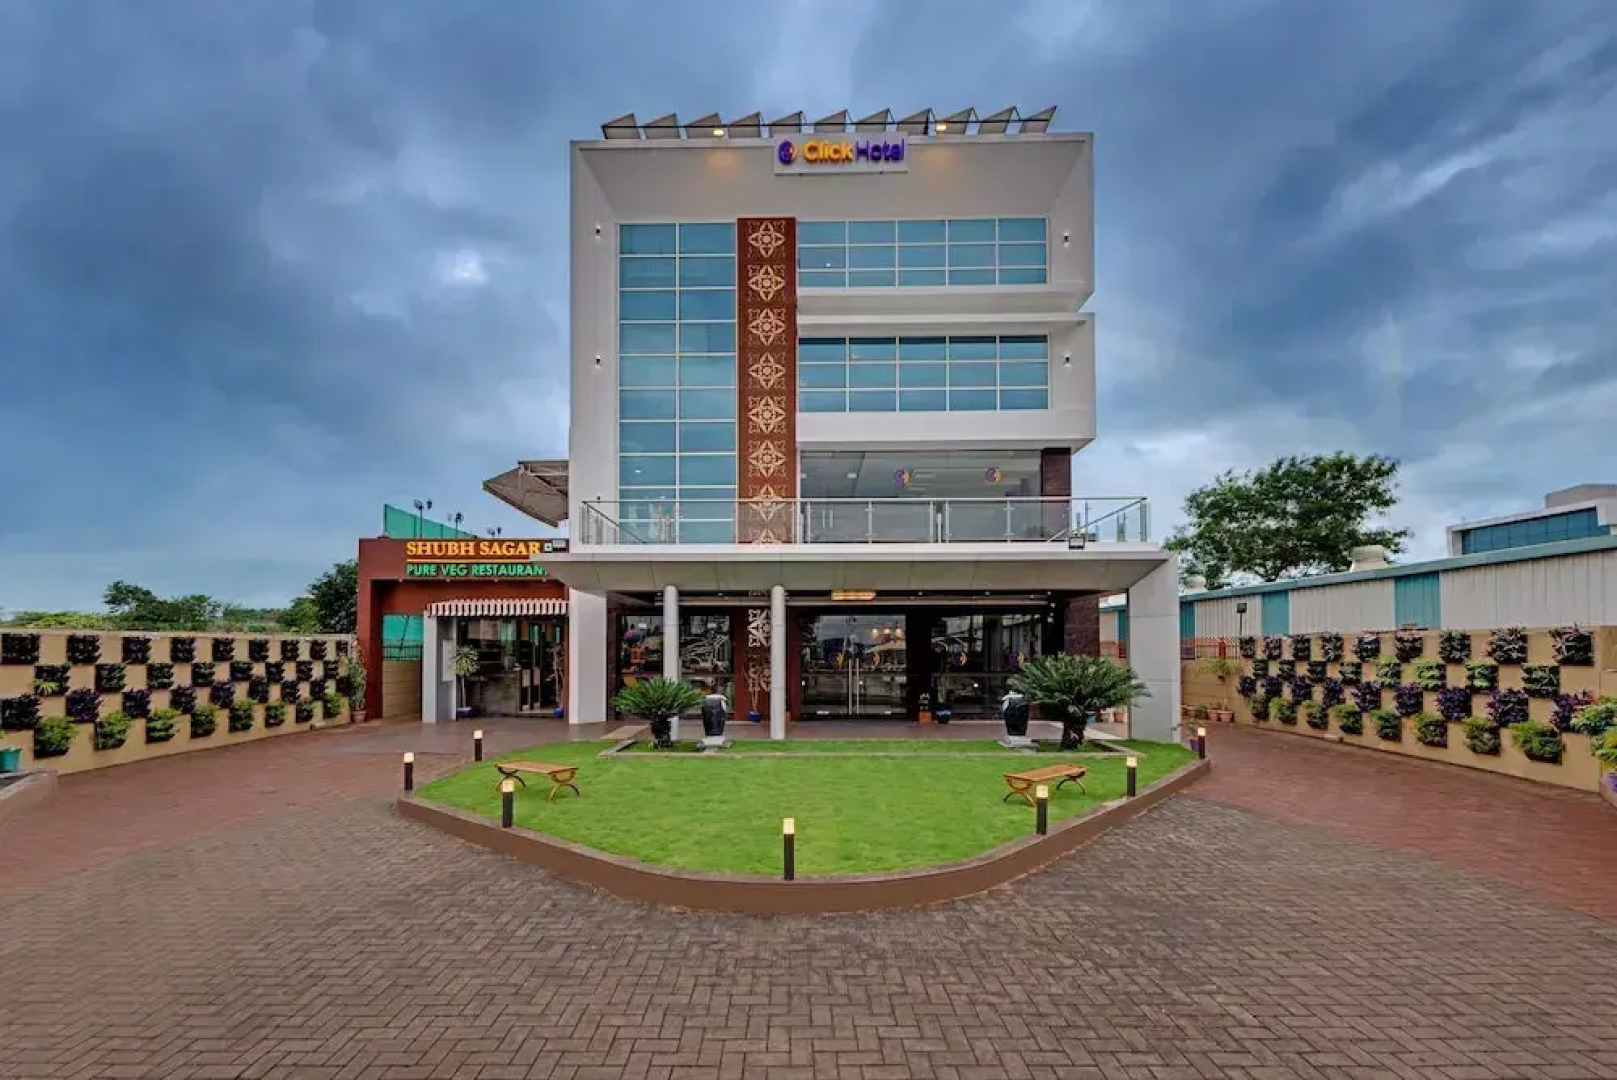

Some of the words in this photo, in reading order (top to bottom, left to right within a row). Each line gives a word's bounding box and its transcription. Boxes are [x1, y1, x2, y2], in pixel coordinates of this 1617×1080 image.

[804, 139, 852, 164] Click
[855, 138, 904, 162] Hotel
[406, 541, 475, 556] SHUBH
[480, 542, 540, 556] SAGAR
[406, 564, 436, 576] PURE
[442, 564, 468, 576] VEG
[471, 564, 548, 576] RESTAURAN
